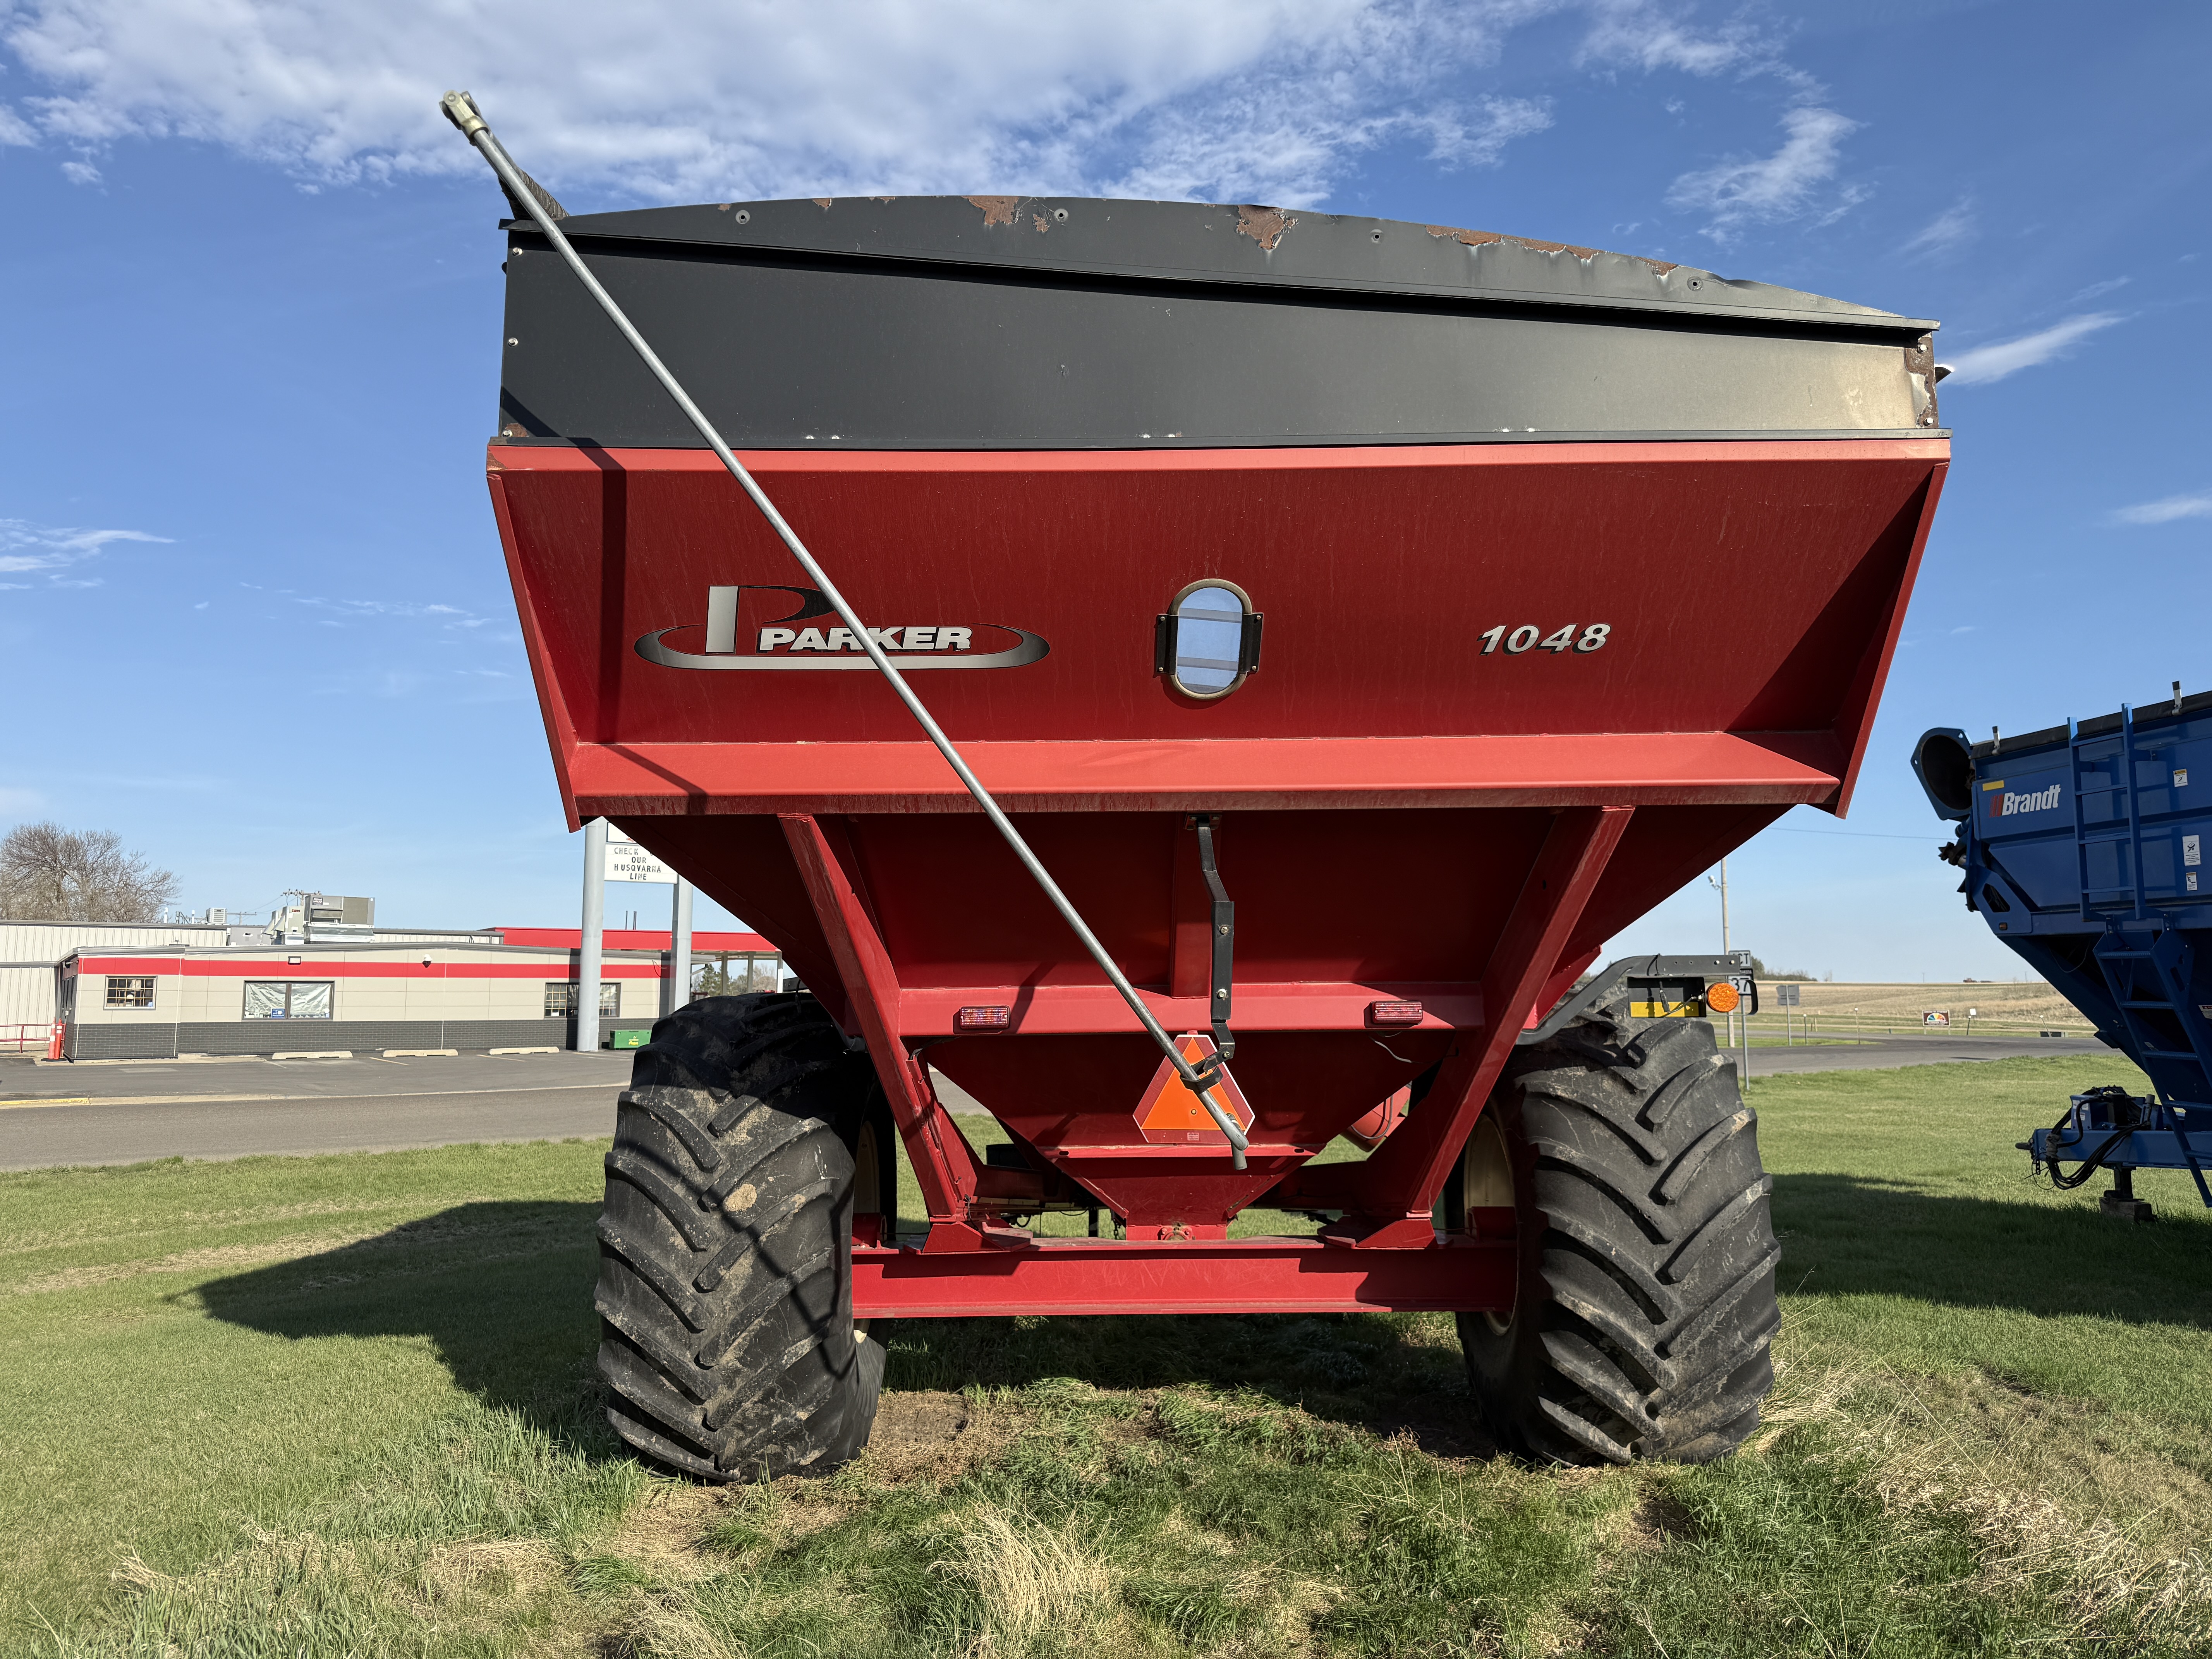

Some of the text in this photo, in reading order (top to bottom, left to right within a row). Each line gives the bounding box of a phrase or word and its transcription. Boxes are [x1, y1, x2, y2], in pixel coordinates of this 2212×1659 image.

[757, 627, 972, 653] PARKER
[1477, 623, 1611, 656] 1048
[2002, 784, 2061, 816] Brandt
[614, 864, 661, 872] HUSQVARNA
[1731, 978, 1749, 992] 37
